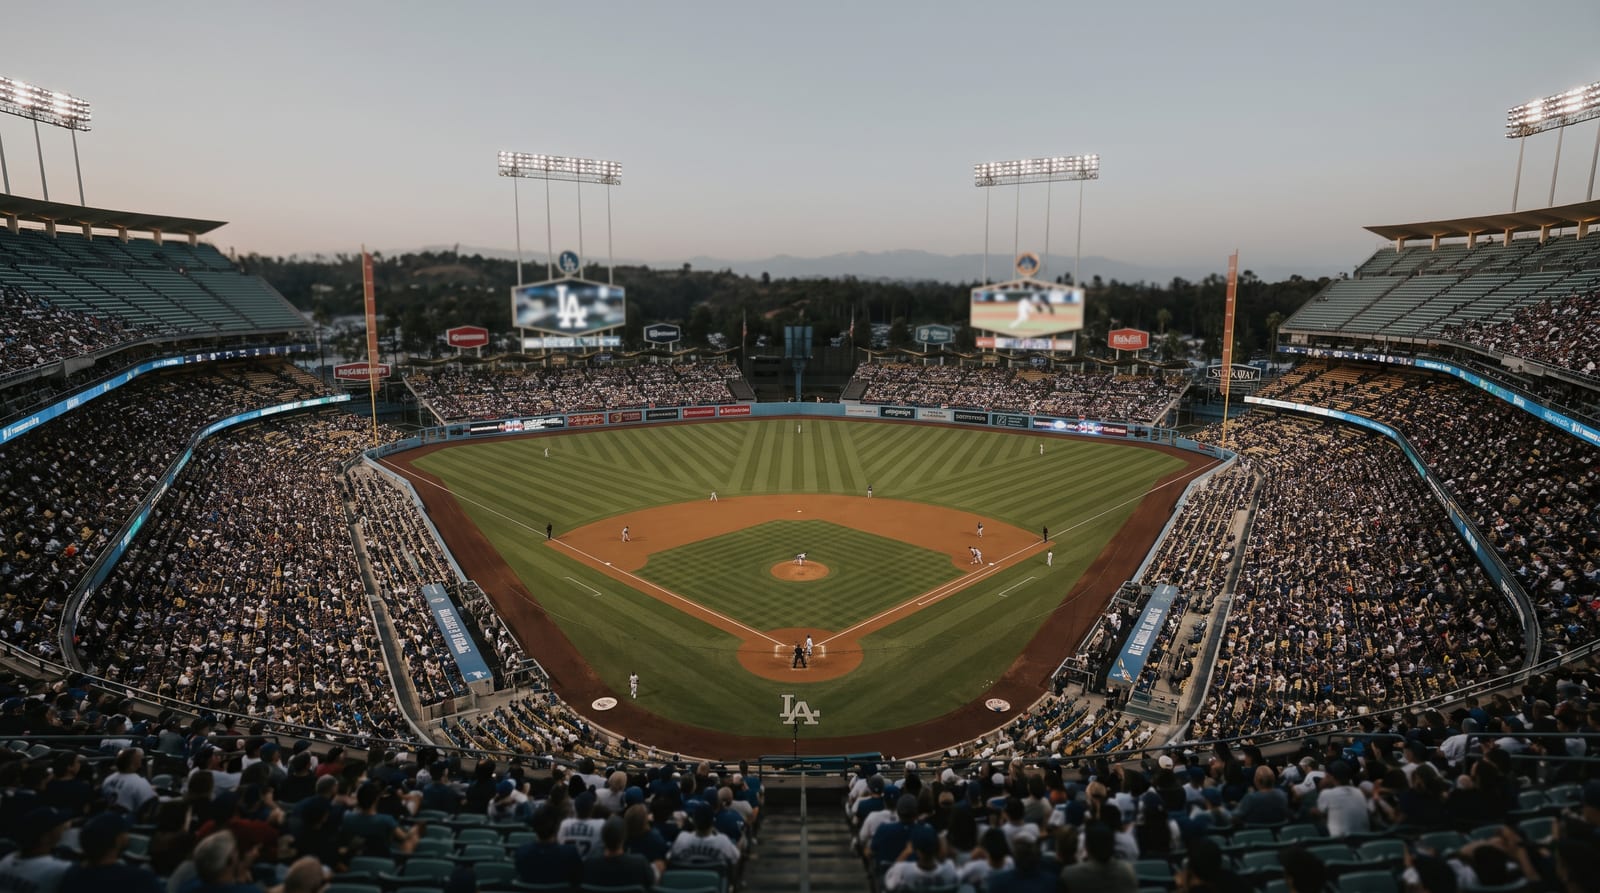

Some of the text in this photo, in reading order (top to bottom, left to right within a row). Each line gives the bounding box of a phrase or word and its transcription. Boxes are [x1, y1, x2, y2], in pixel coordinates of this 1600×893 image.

[563, 253, 576, 271] LA
[556, 285, 588, 328] LA
[779, 694, 821, 725] LA
